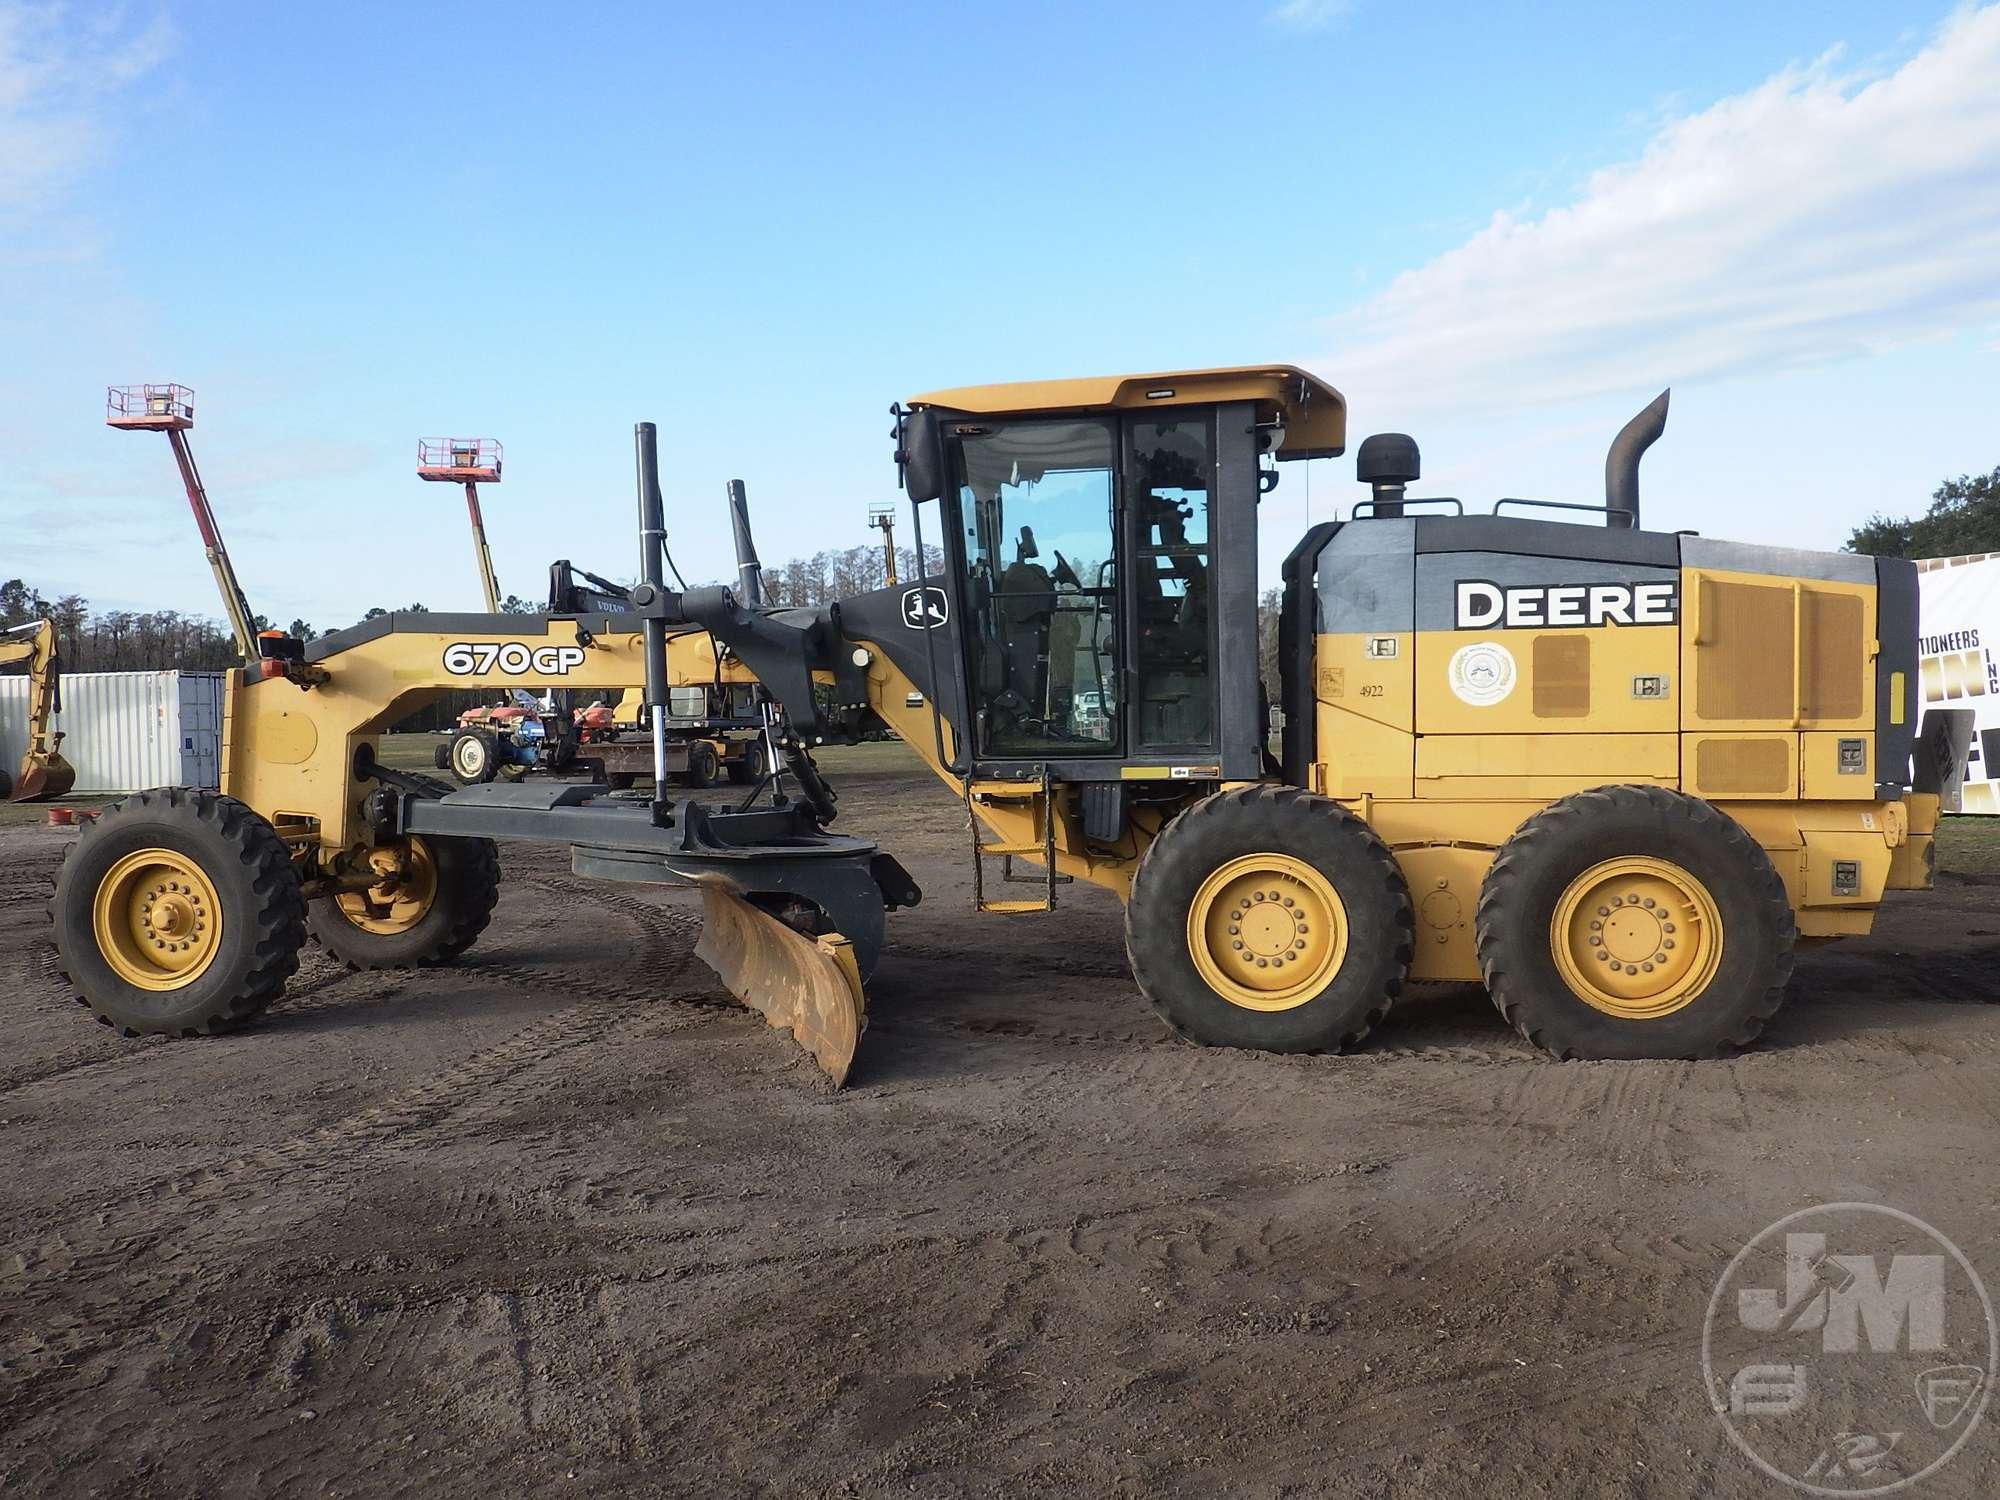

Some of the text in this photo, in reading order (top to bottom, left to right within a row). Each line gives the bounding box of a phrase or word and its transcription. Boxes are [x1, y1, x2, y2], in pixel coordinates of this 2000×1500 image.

[1456, 581, 1675, 629] DEERE
[443, 642, 586, 675] 670GP
[1360, 685, 1384, 697] 4922
